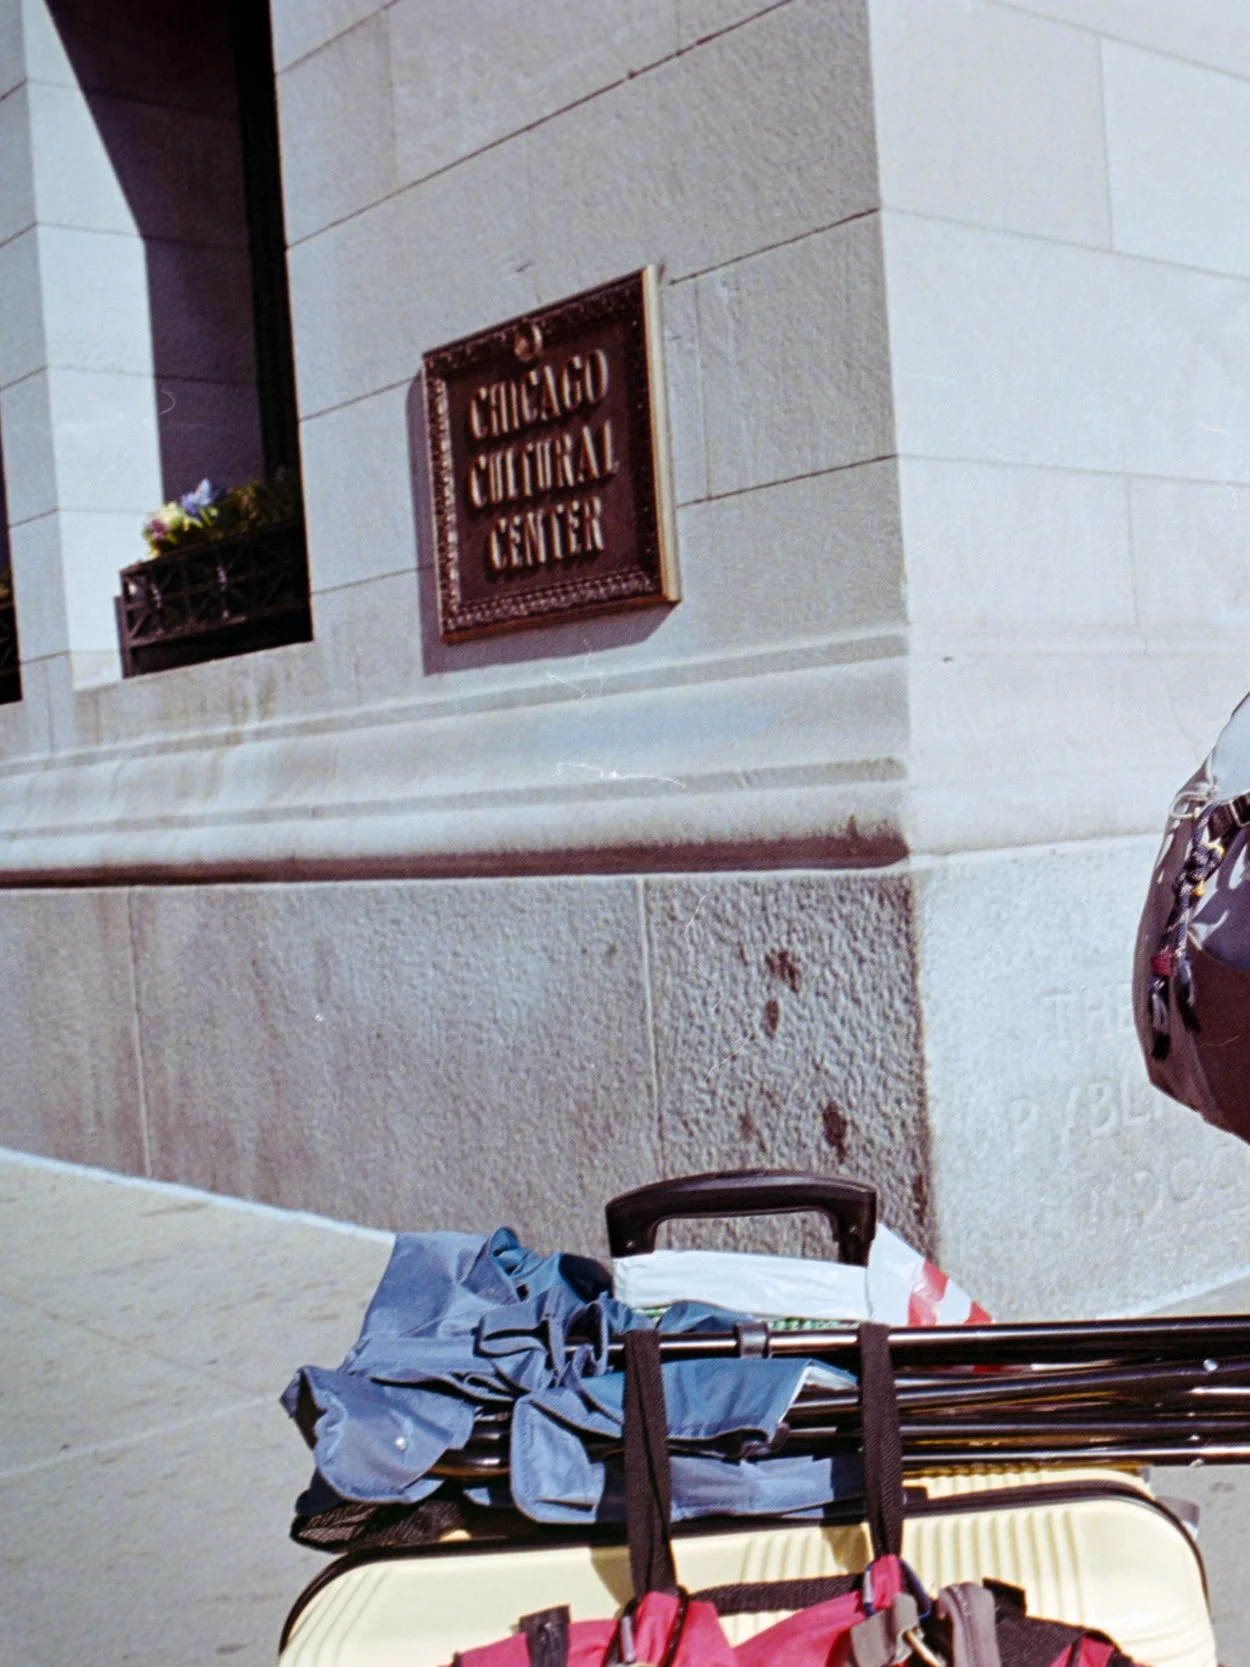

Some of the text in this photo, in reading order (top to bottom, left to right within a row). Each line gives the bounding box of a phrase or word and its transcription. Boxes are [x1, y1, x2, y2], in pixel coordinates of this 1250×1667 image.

[468, 349, 609, 440] CHICAGO
[468, 420, 619, 508] CULTURAL
[489, 496, 604, 571] CENTER
